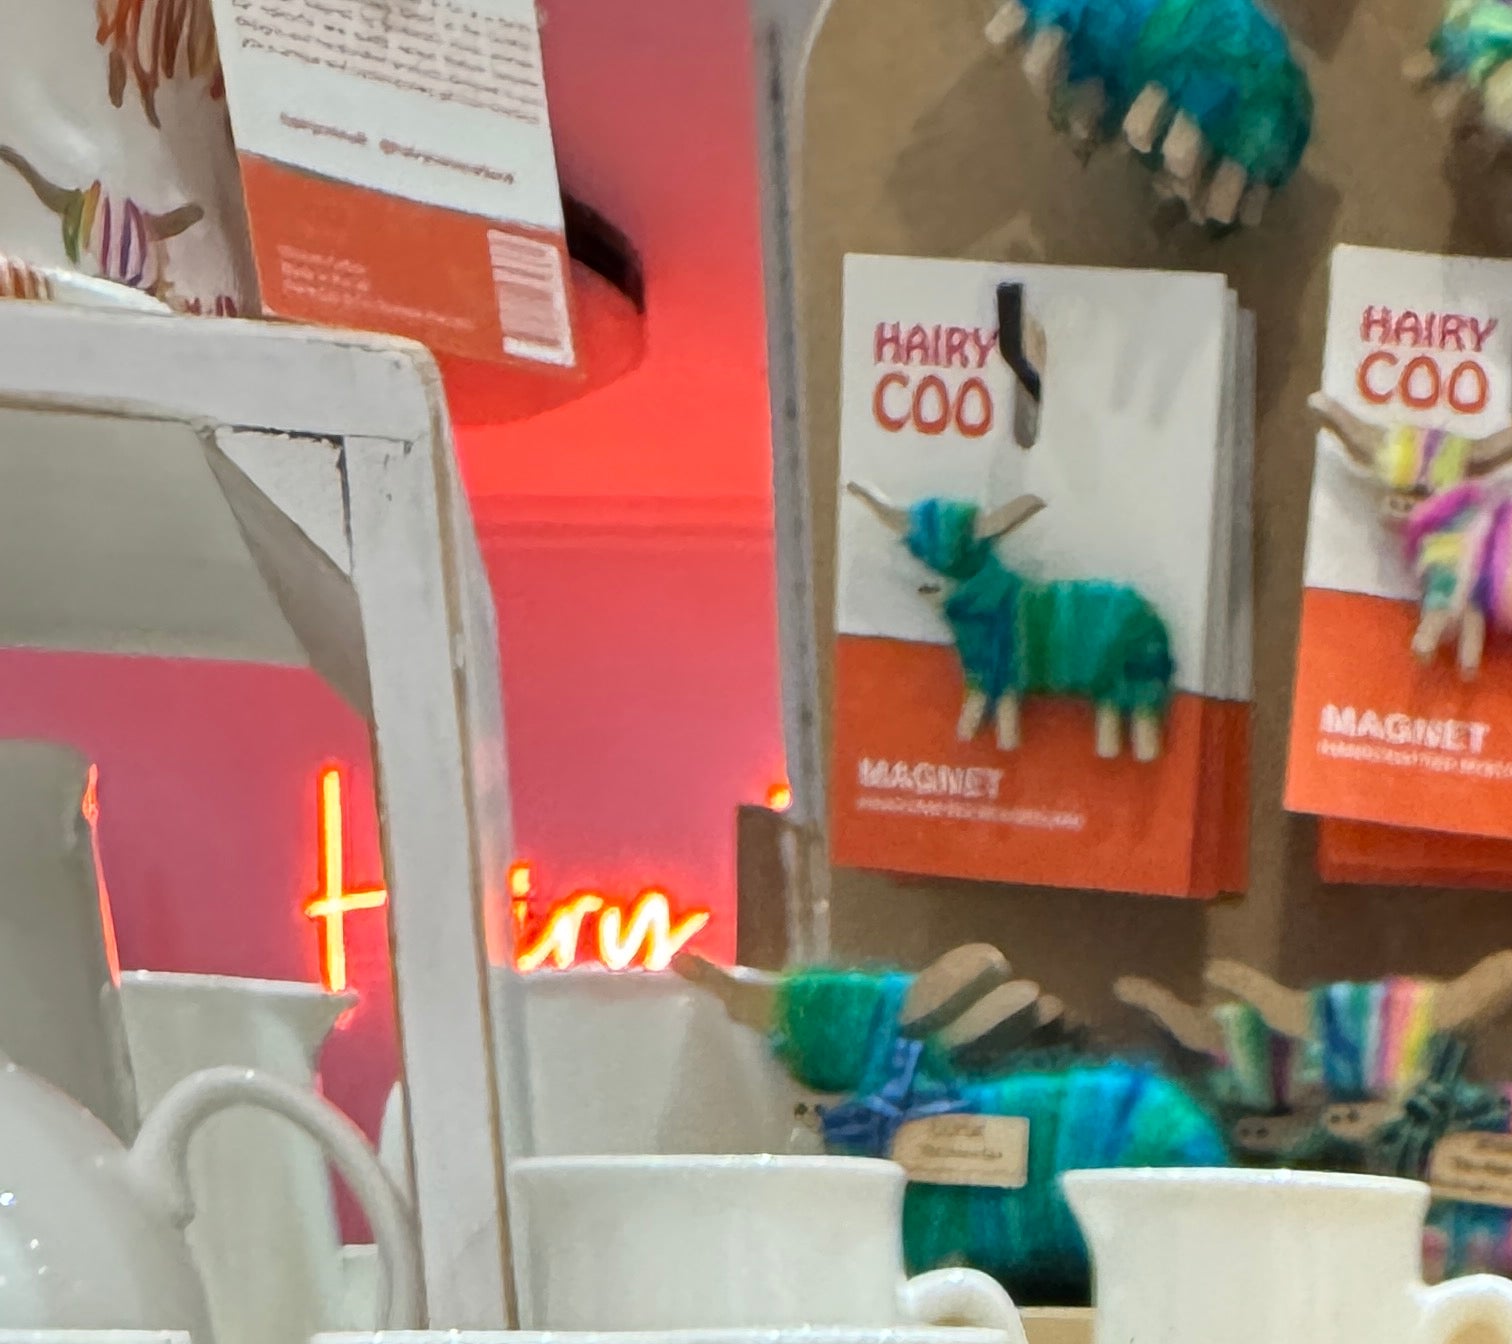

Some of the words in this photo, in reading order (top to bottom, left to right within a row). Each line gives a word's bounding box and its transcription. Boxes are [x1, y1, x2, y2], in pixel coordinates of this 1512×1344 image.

[873, 322, 997, 368] HAIRY
[1361, 305, 1498, 351] HAIRY
[873, 372, 994, 438] COO
[1356, 351, 1489, 414] COO
[1321, 704, 1490, 754] MAGNET
[858, 757, 1004, 798] MAGNET
